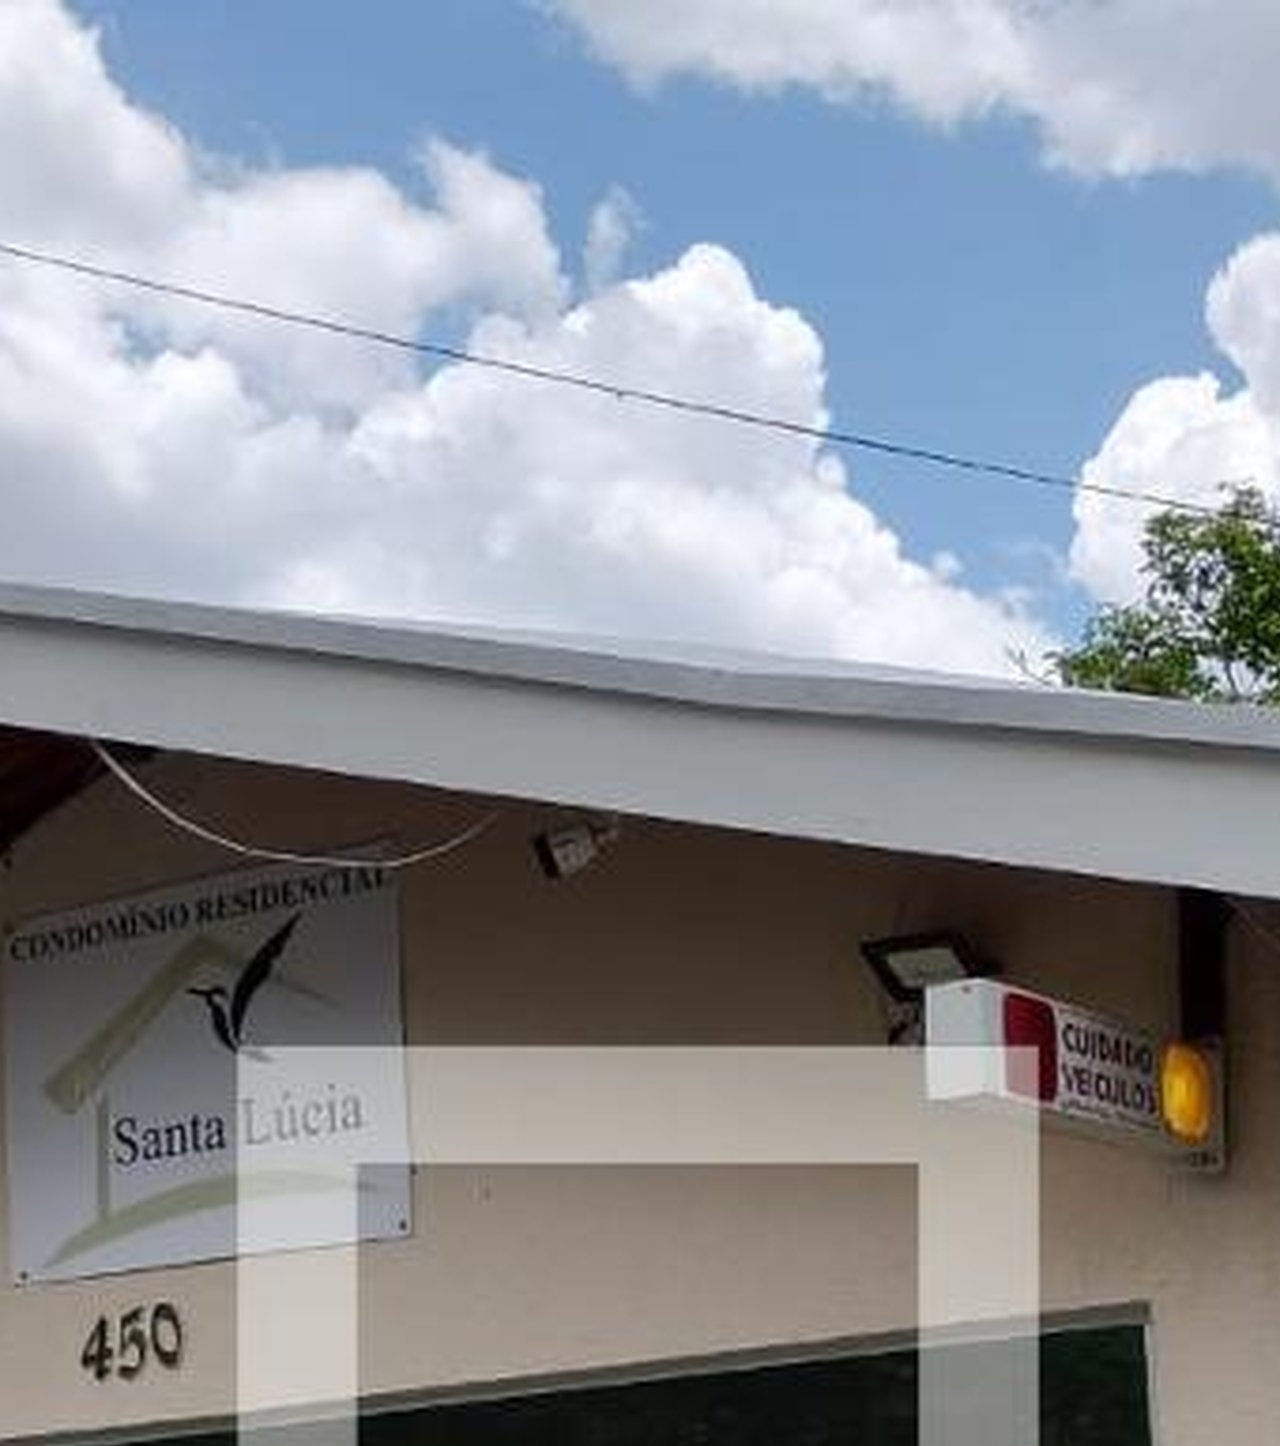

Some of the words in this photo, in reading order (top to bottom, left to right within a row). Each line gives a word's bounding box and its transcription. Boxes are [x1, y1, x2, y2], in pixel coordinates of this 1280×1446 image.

[196, 866, 386, 922] RESIDENCIAL
[1062, 1023, 1153, 1075] CUIDADO
[112, 1113, 228, 1167] Santa
[239, 1082, 365, 1146] Lúcia
[81, 1302, 182, 1381] 450
